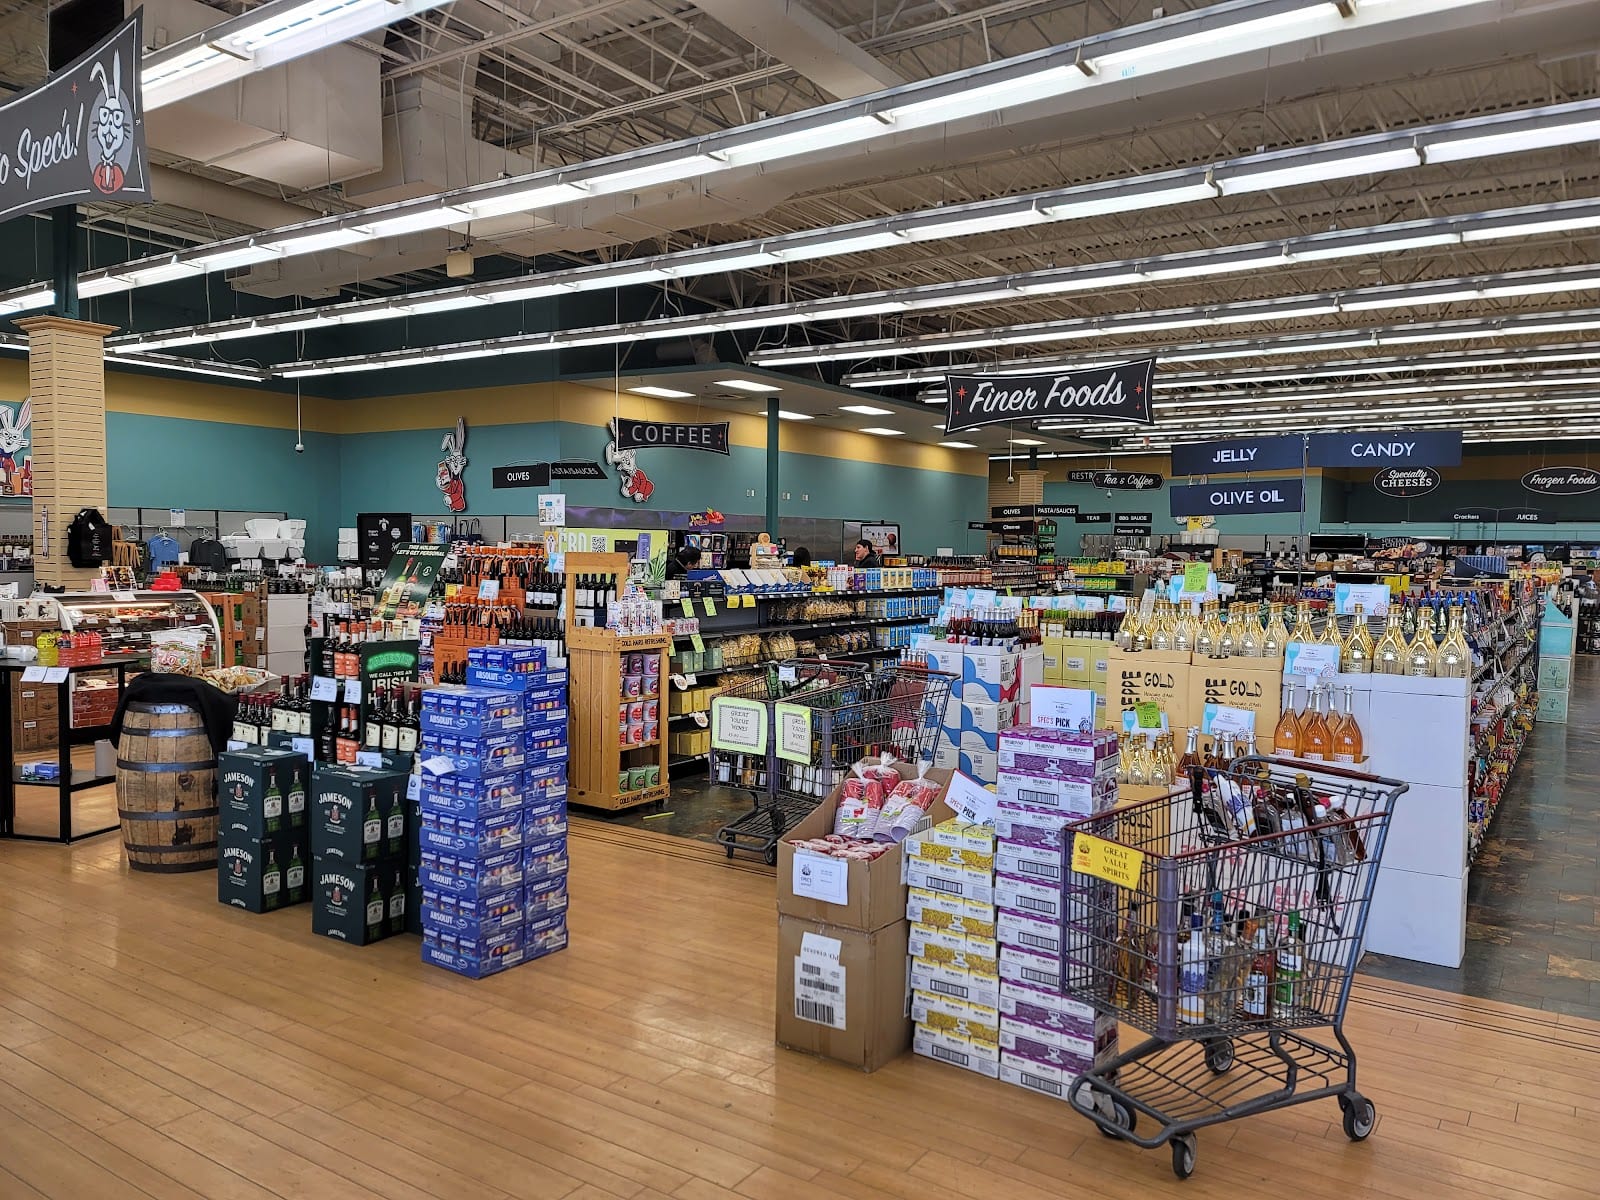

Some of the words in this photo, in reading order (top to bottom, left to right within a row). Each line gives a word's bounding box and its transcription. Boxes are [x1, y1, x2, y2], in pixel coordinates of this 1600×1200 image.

[0, 153, 9, 184] o
[15, 102, 84, 190] Spec's!
[969, 382, 1039, 413] Finer
[1044, 372, 1126, 408] Foods
[632, 425, 712, 444] COFFEE
[1212, 448, 1257, 462] JELLY
[1351, 442, 1415, 457] CANDY
[507, 472, 530, 481] OLIVES
[1388, 469, 1428, 480] Specialty
[1103, 474, 1117, 484] Tea
[1127, 475, 1154, 488] Coffee
[1381, 478, 1432, 488] CHEESES
[1530, 474, 1565, 488] Frozen
[1567, 474, 1597, 484] Foods
[1210, 491, 1254, 506] OLIVE
[1260, 490, 1284, 503] OIL
[512, 650, 531, 658] ABSOLUT
[476, 671, 499, 681] ABSOLUT
[1144, 672, 1174, 688] GOLD
[532, 690, 549, 698] ABSOLUT
[1230, 680, 1262, 698] GOLD
[487, 696, 507, 704] ABSOLUT
[429, 715, 453, 726] ABSOLUT
[1037, 716, 1054, 724] SPEC'S
[1055, 717, 1070, 728] PICK
[532, 729, 550, 737] ABSOLUT
[487, 736, 507, 745] ABSOLUT
[531, 767, 550, 776] ABSOLUT
[224, 772, 254, 788] JAMESON
[318, 792, 352, 810] JAMESON
[428, 794, 451, 806] ABSOLUT
[962, 806, 976, 821] PICK
[485, 816, 505, 825] ABSOLUT
[428, 833, 451, 844] ABSOLUT
[532, 843, 550, 852] ABSOLUT
[1104, 846, 1128, 859] GREAT
[224, 848, 253, 864] JAMESON
[485, 856, 504, 865] ABSOLUT
[1104, 855, 1128, 870] VALUE
[429, 873, 453, 885] ABSOLUT
[1102, 866, 1129, 880] SPIRITS
[319, 874, 355, 892] JAMESON
[533, 881, 550, 890] ABSOLUT
[486, 895, 506, 905] ABSOLUT
[430, 911, 453, 924] ABSOLUT
[532, 919, 550, 929] ABSOLUT
[486, 933, 506, 945] ABSOLUT
[431, 951, 453, 963] ABSOLUT
